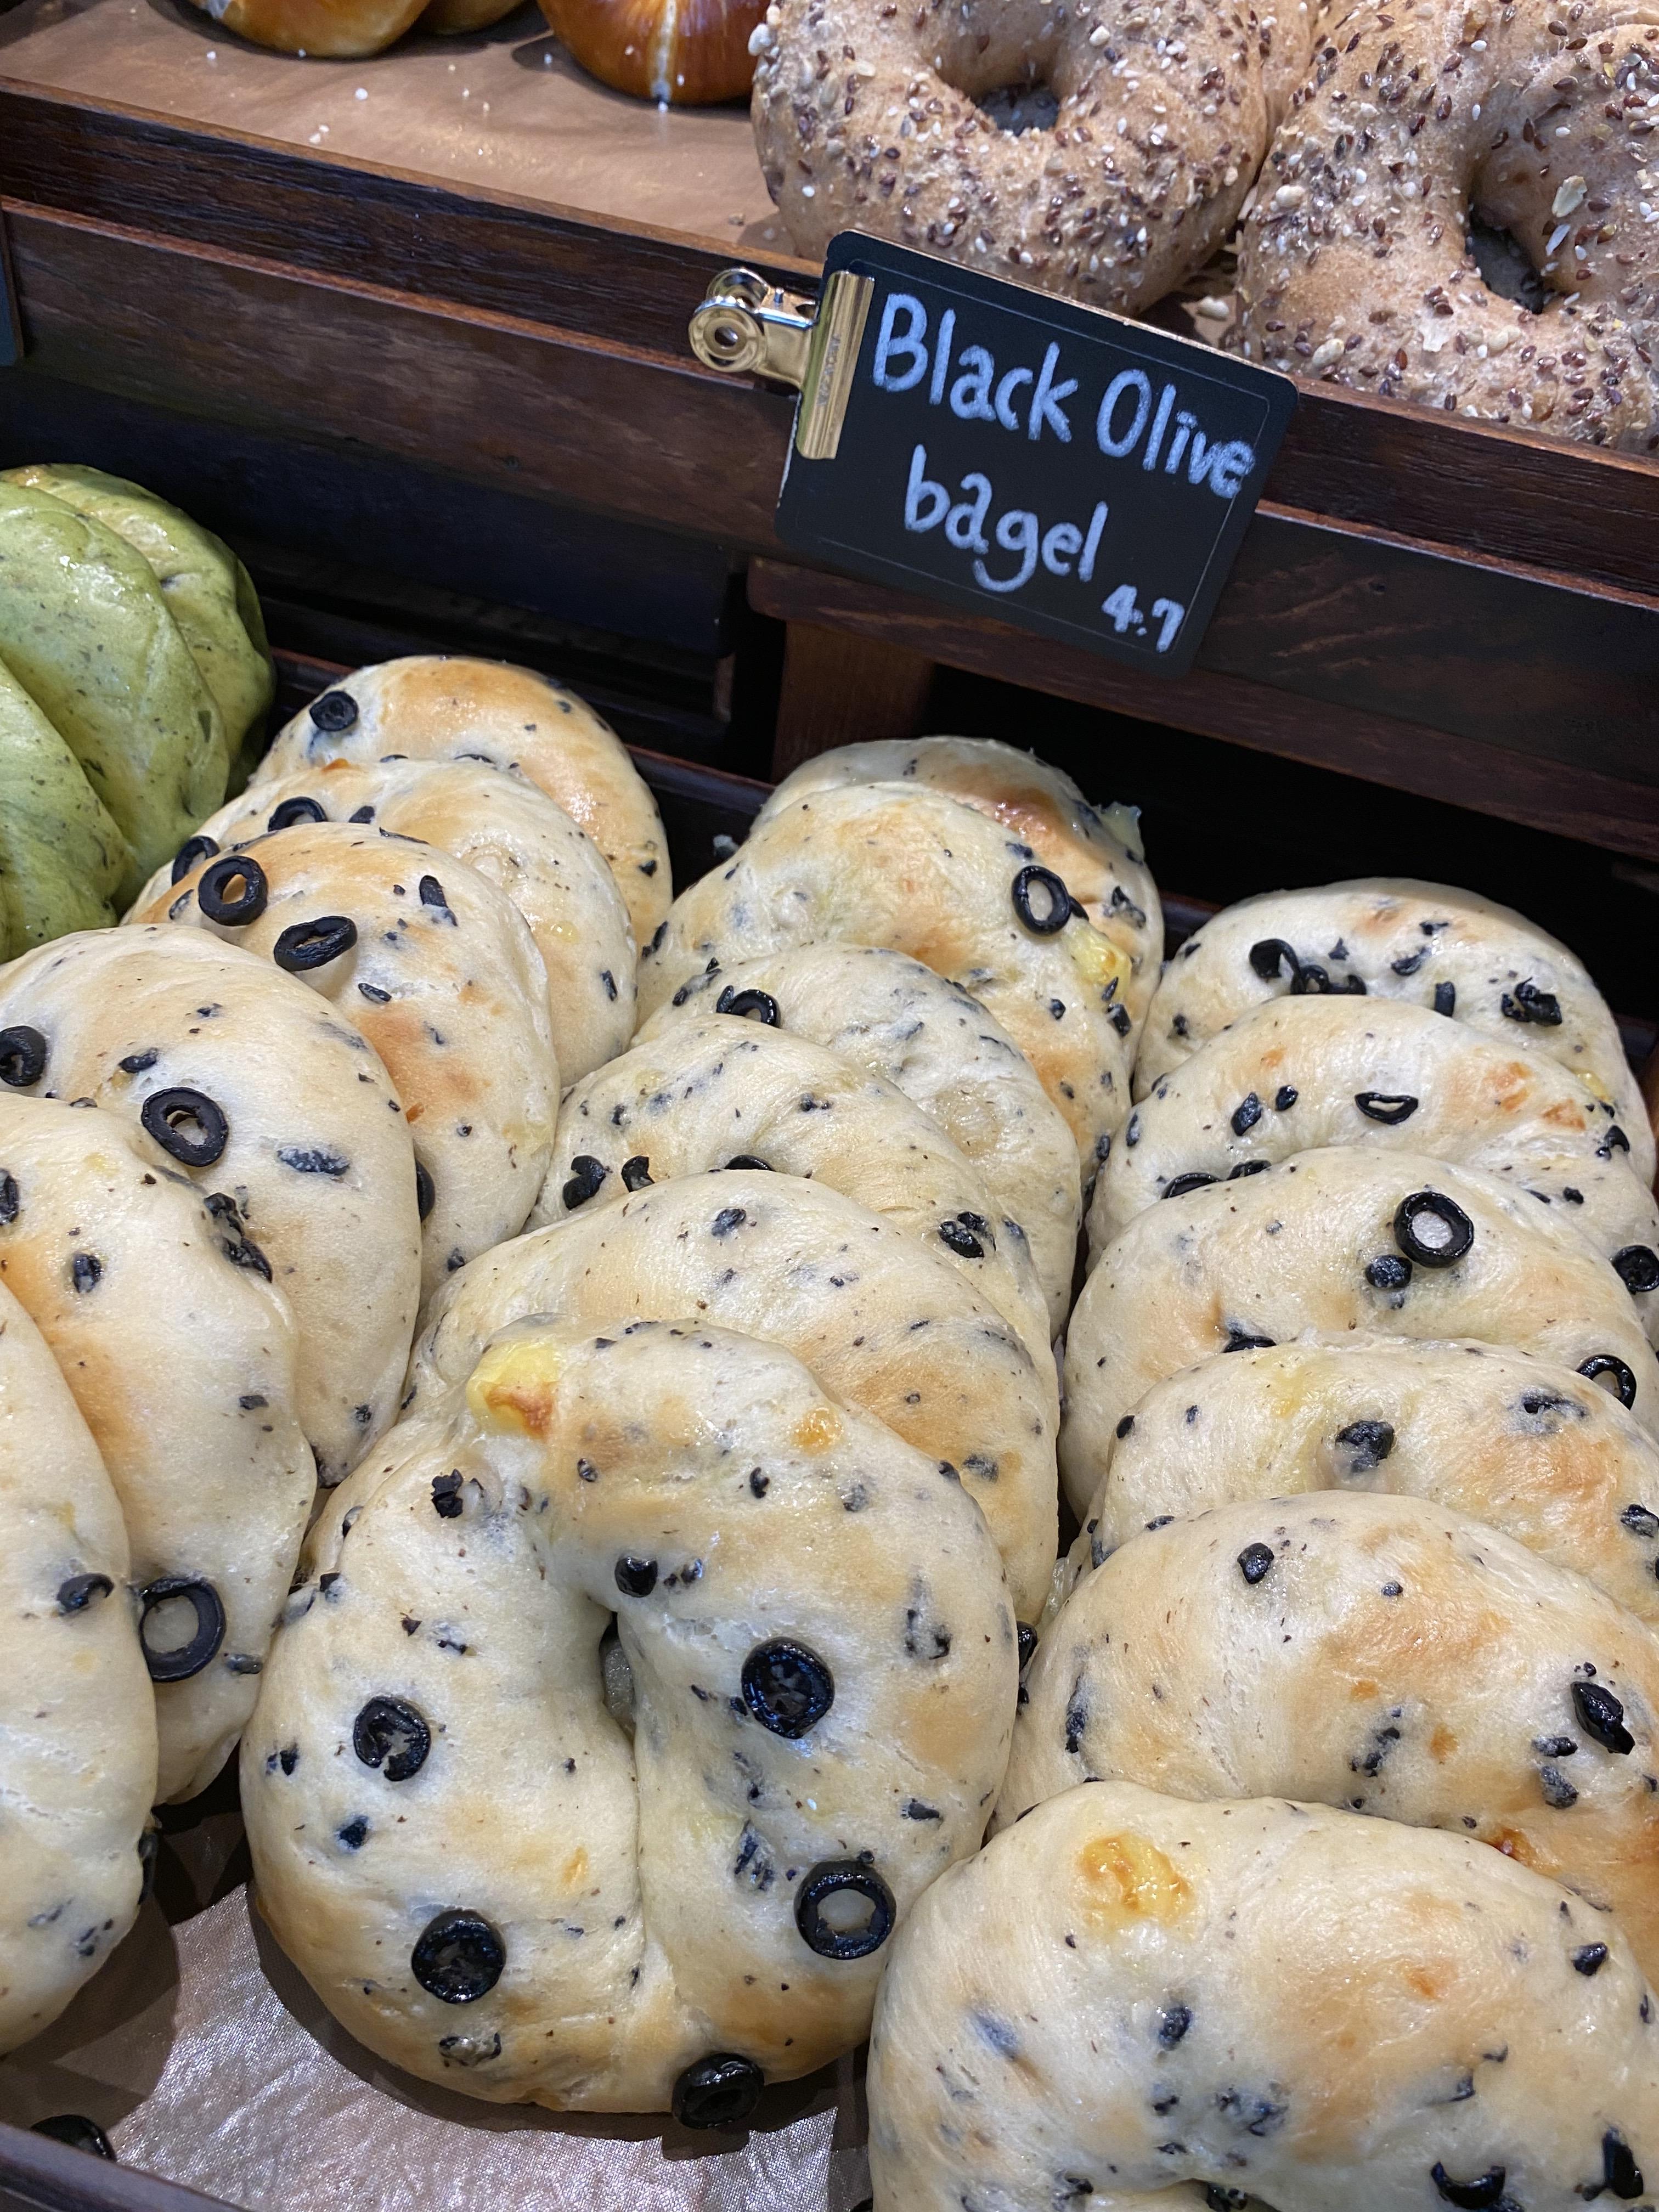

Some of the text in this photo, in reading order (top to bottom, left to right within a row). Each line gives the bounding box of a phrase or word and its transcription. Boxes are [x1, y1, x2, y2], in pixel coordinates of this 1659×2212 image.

[872, 292, 1079, 443] Black
[1097, 369, 1256, 499] Olive
[904, 444, 1109, 592] bagel
[1101, 584, 1186, 653] 4.7
